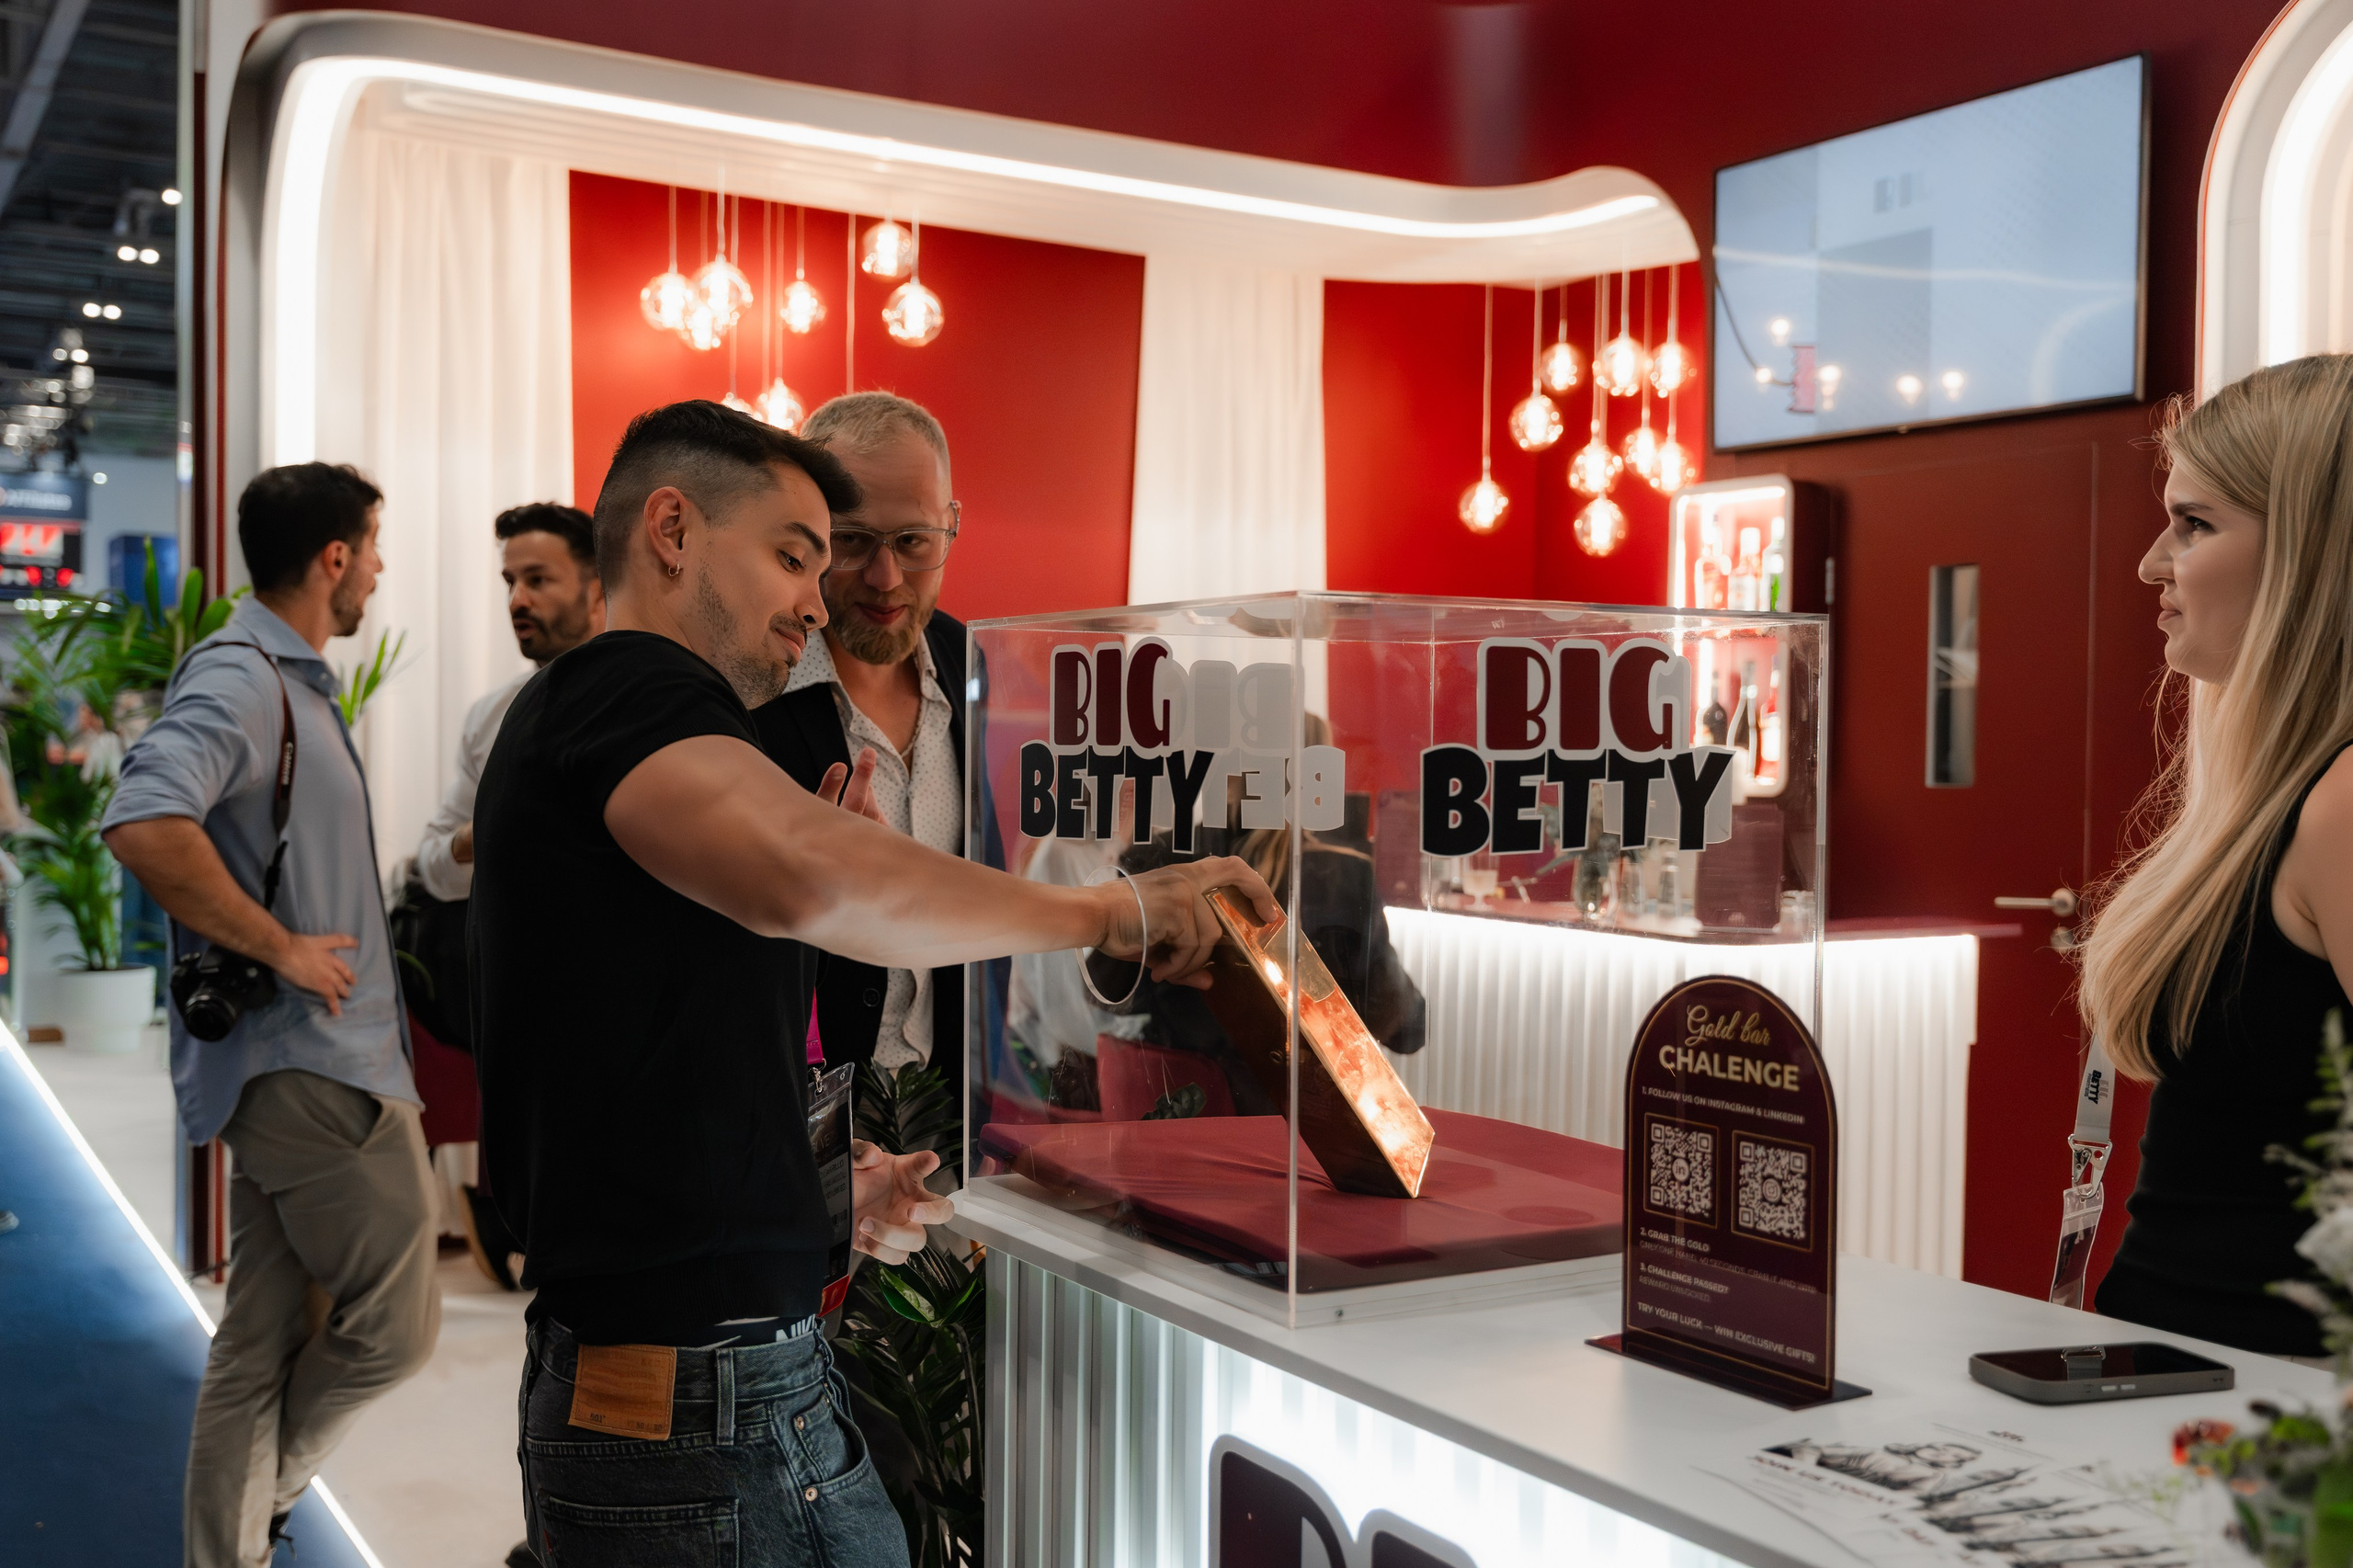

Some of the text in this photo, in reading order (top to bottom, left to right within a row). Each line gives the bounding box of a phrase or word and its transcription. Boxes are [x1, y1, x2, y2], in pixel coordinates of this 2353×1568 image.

[1053, 642, 1172, 750] BIG
[1484, 644, 1674, 753] BIG
[1019, 742, 1216, 853] BETTY
[1421, 745, 1735, 858] BETTY
[1684, 1004, 1771, 1047] Gold bar
[1658, 1044, 1801, 1093] CHALENGE
[2088, 1070, 2102, 1104] BETTY
[1648, 1087, 1681, 1101] FOLLOW
[1682, 1094, 1693, 1103] US
[1694, 1096, 1706, 1106] ON
[1707, 1097, 1755, 1115] INSTAGRAM
[1640, 1226, 1711, 1252] 2. GRAB THE GOLD
[1647, 1264, 1693, 1284] CHALLENGE
[1637, 1301, 1654, 1313] TRY
[1654, 1306, 1678, 1322] YOUR
[1679, 1314, 1703, 1330] LUCK
[1714, 1324, 1735, 1338] WIN
[1735, 1330, 1785, 1355] EXCLUSIVE
